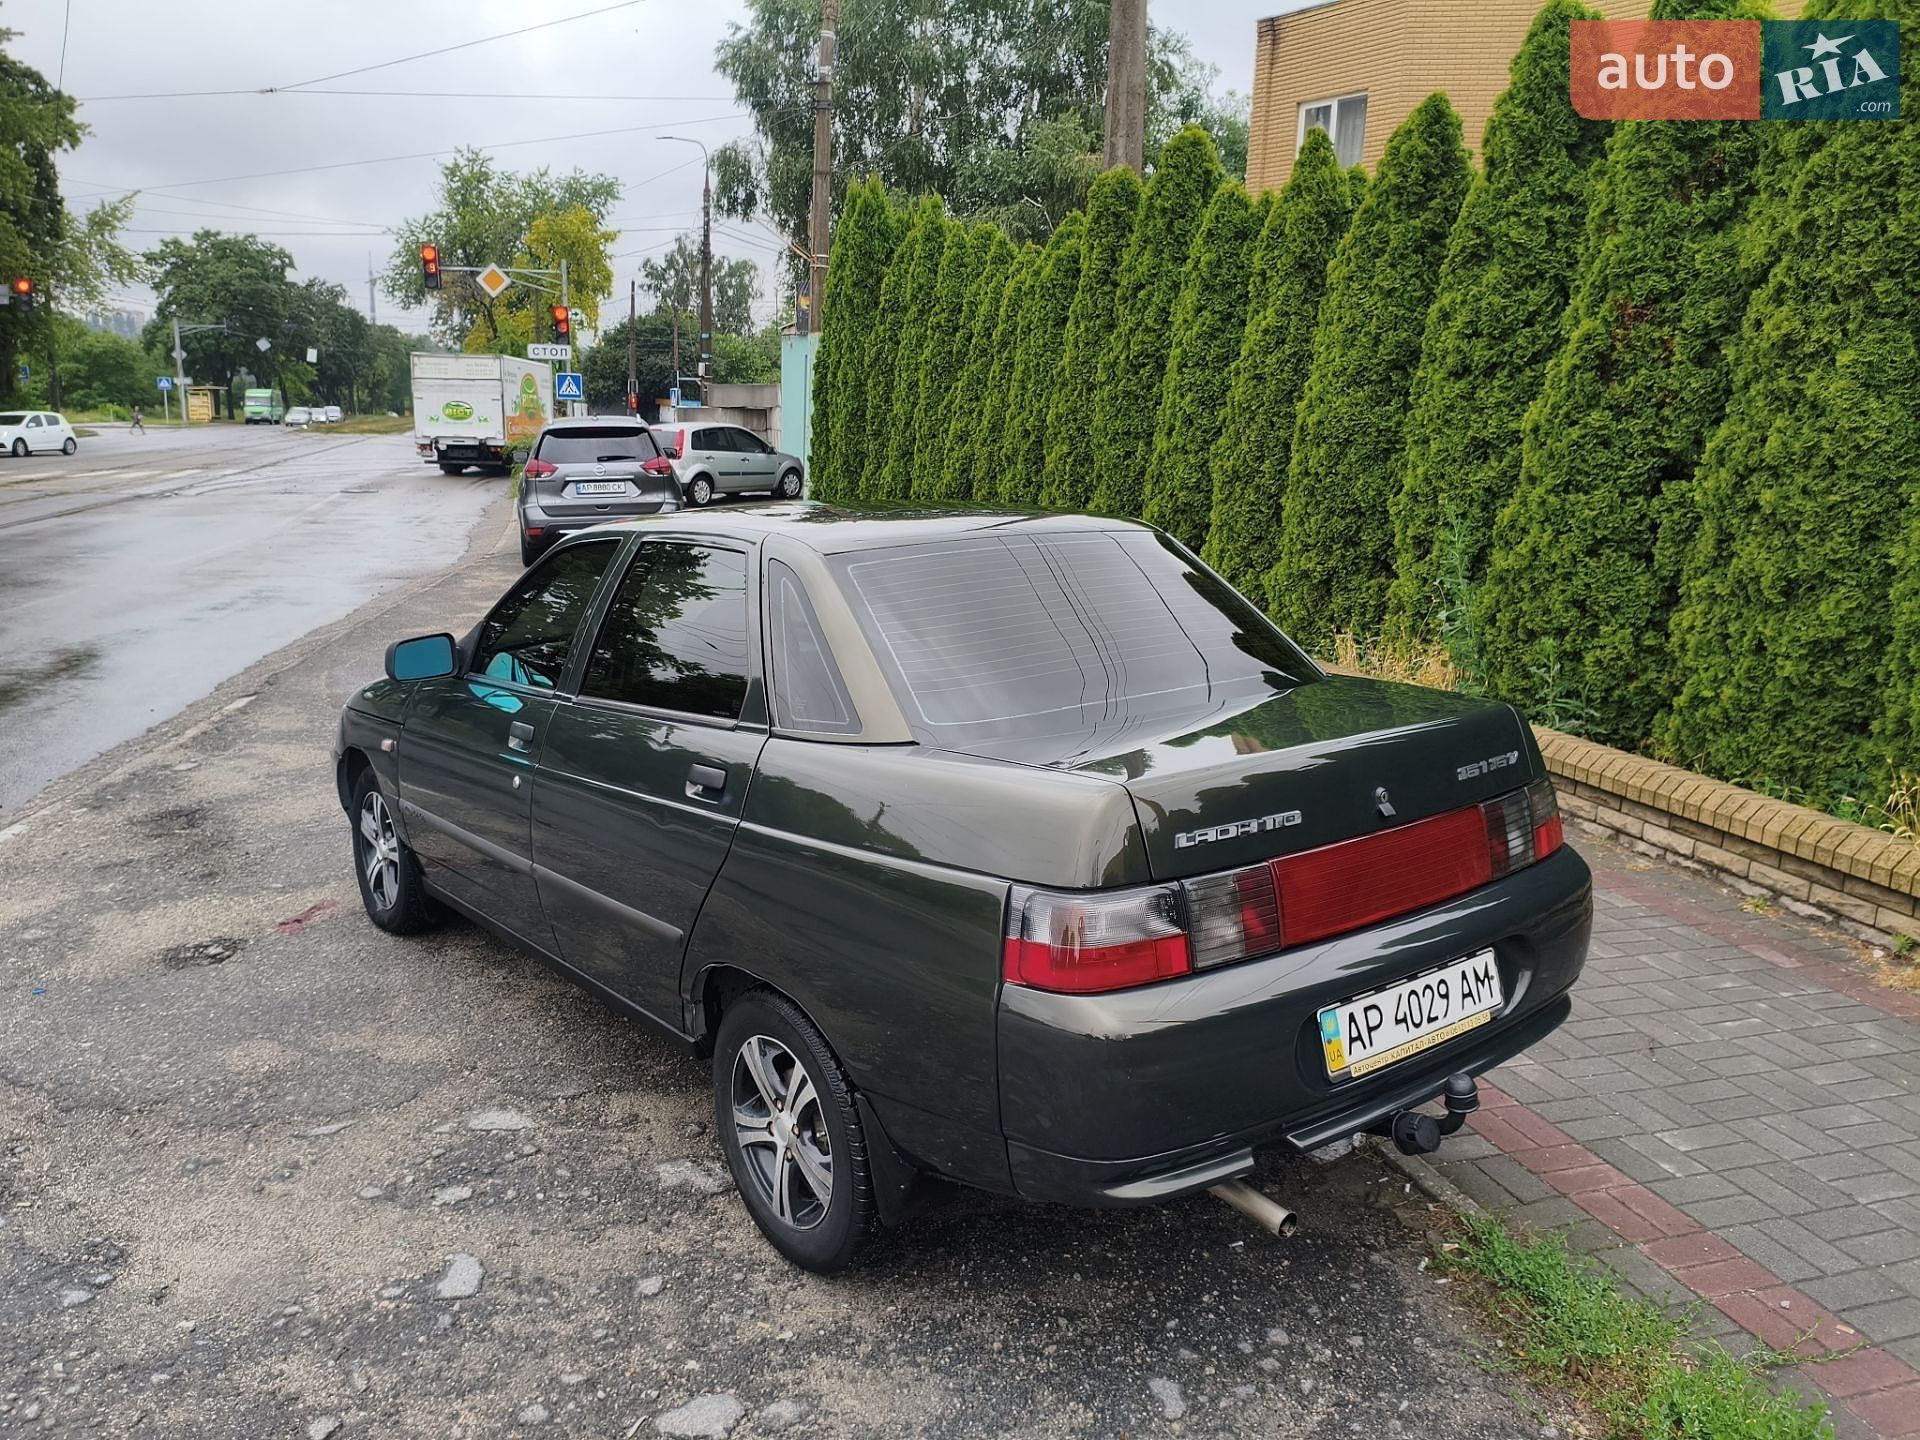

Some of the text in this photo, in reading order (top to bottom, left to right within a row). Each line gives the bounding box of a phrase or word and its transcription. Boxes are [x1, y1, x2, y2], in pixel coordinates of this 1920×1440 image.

[532, 347, 568, 357] СТОП
[1174, 810, 1302, 849] LADA 110
[1348, 961, 1494, 1056] AP 4029 AM
[1328, 1048, 1344, 1063] UA
